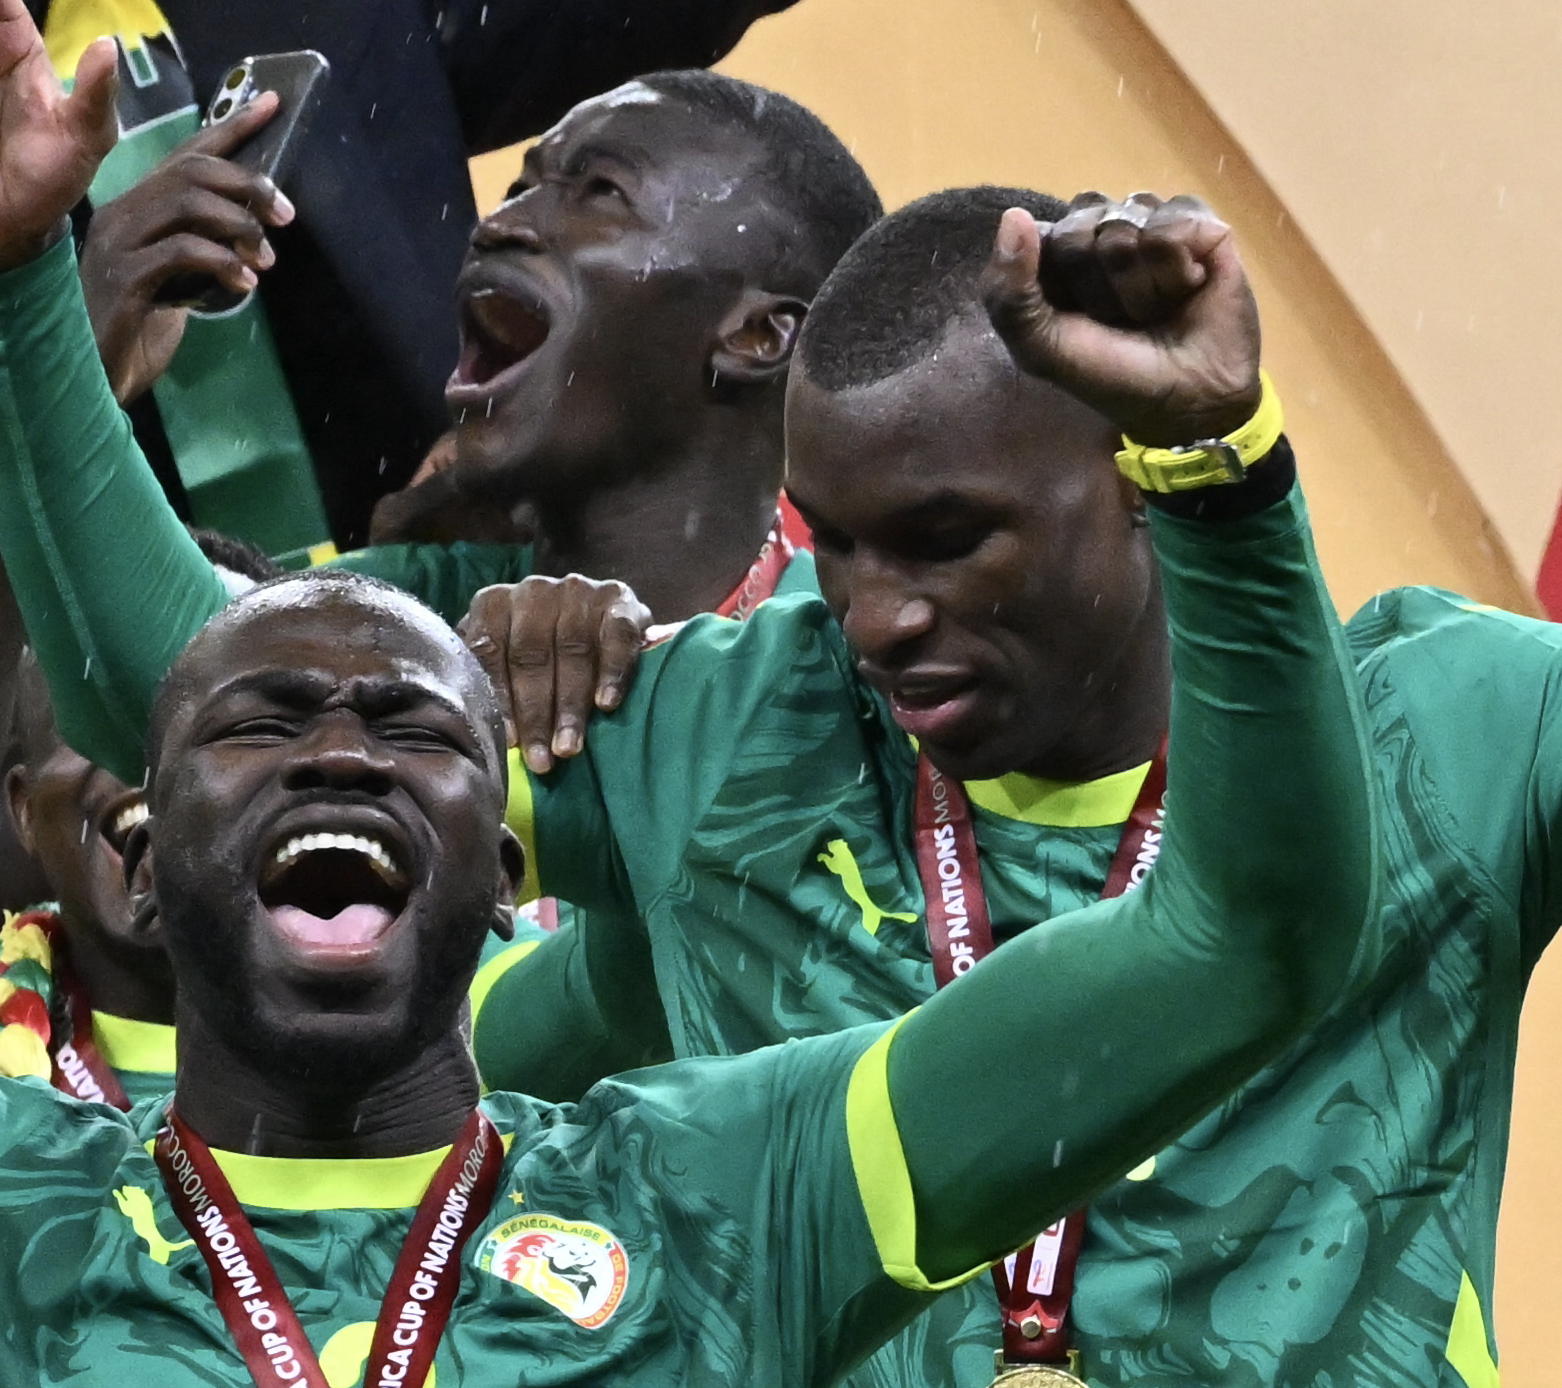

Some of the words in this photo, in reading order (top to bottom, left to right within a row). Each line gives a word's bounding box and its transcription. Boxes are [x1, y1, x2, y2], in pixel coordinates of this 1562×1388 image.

[933, 823, 971, 940] NATIONS
[950, 941, 976, 978] OF
[196, 1204, 263, 1299] NATIONS
[420, 1187, 469, 1275] NATIONS
[409, 1266, 438, 1301] OF
[243, 1300, 278, 1331] OF
[393, 1298, 426, 1346] CUP
[261, 1331, 301, 1380] CUP
